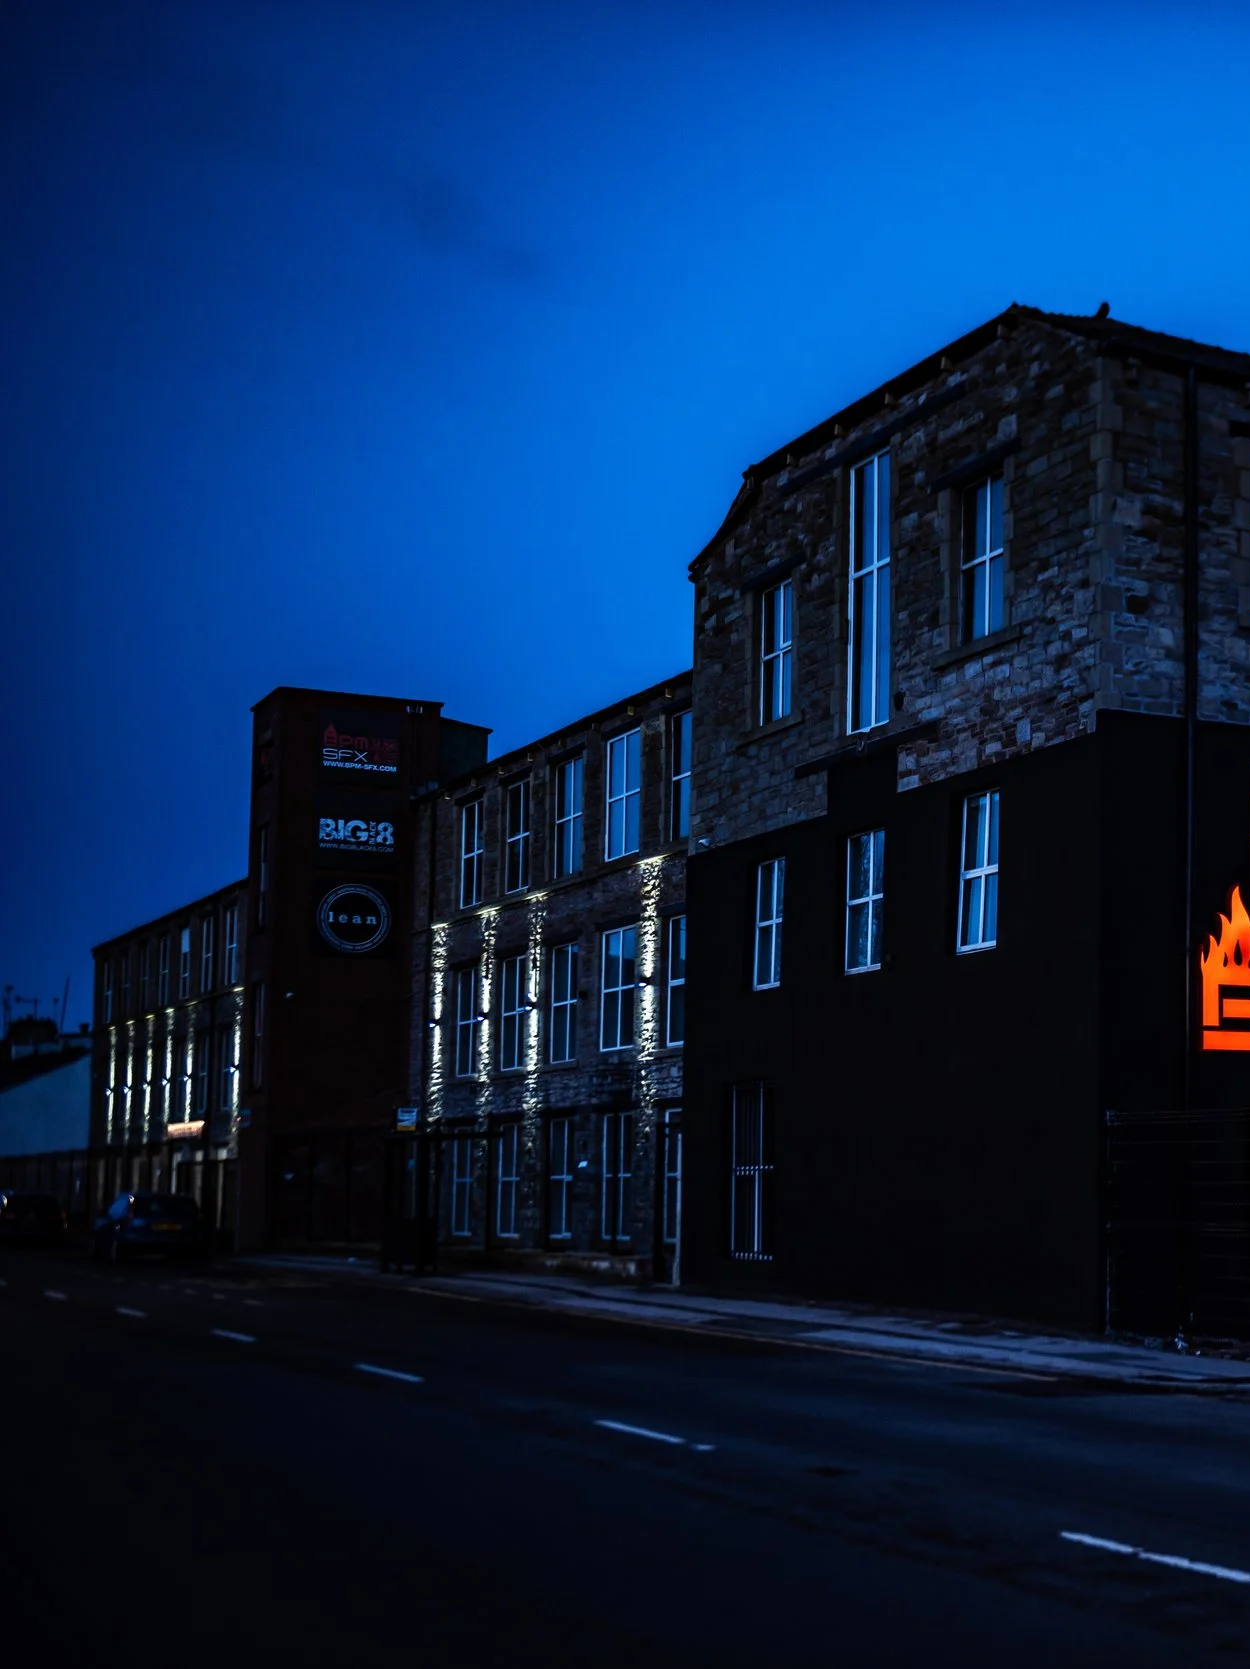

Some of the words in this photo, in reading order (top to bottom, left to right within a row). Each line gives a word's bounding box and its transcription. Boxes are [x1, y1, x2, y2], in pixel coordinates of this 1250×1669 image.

[322, 748, 368, 763] SFX
[322, 760, 397, 773] WWW.BPM-SFX.COM
[319, 818, 369, 842] BIG
[376, 822, 394, 845] 8
[328, 911, 378, 925] lean
